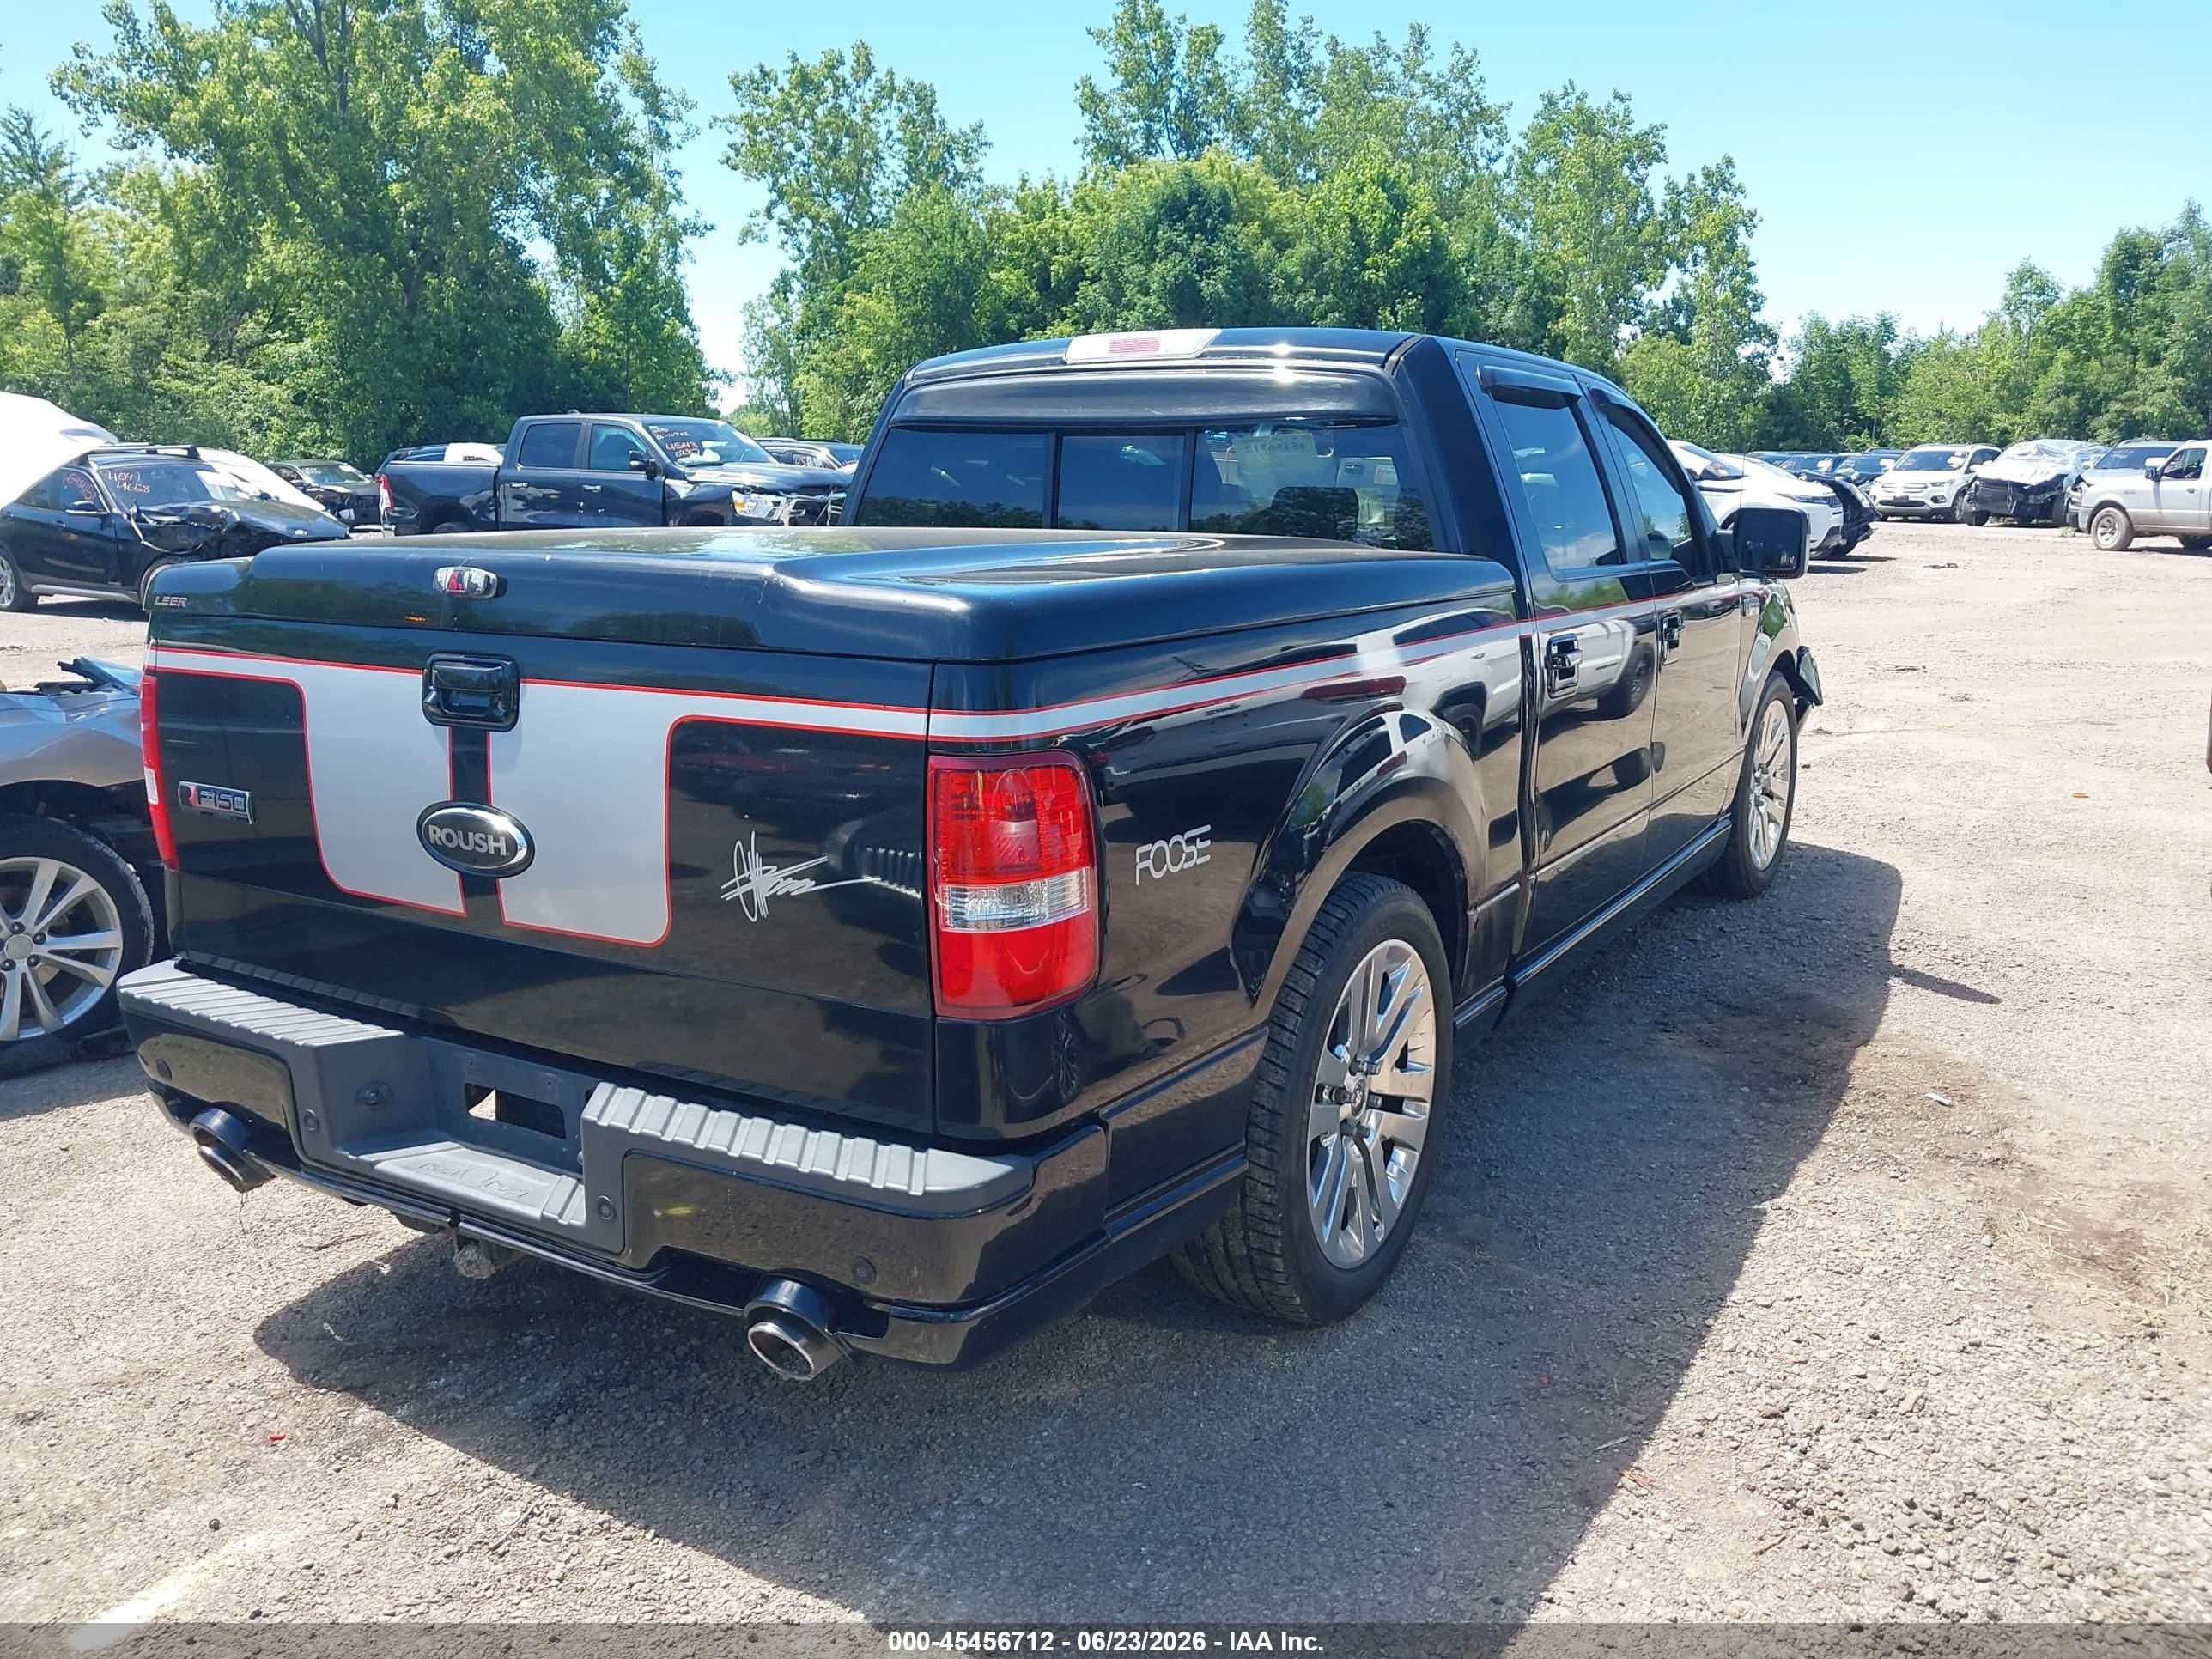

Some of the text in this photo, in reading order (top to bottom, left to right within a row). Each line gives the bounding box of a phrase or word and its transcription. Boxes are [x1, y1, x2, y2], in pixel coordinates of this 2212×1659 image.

[154, 596, 188, 607] LEER
[428, 823, 507, 856] ROUSH
[1135, 824, 1212, 886] FOOSE
